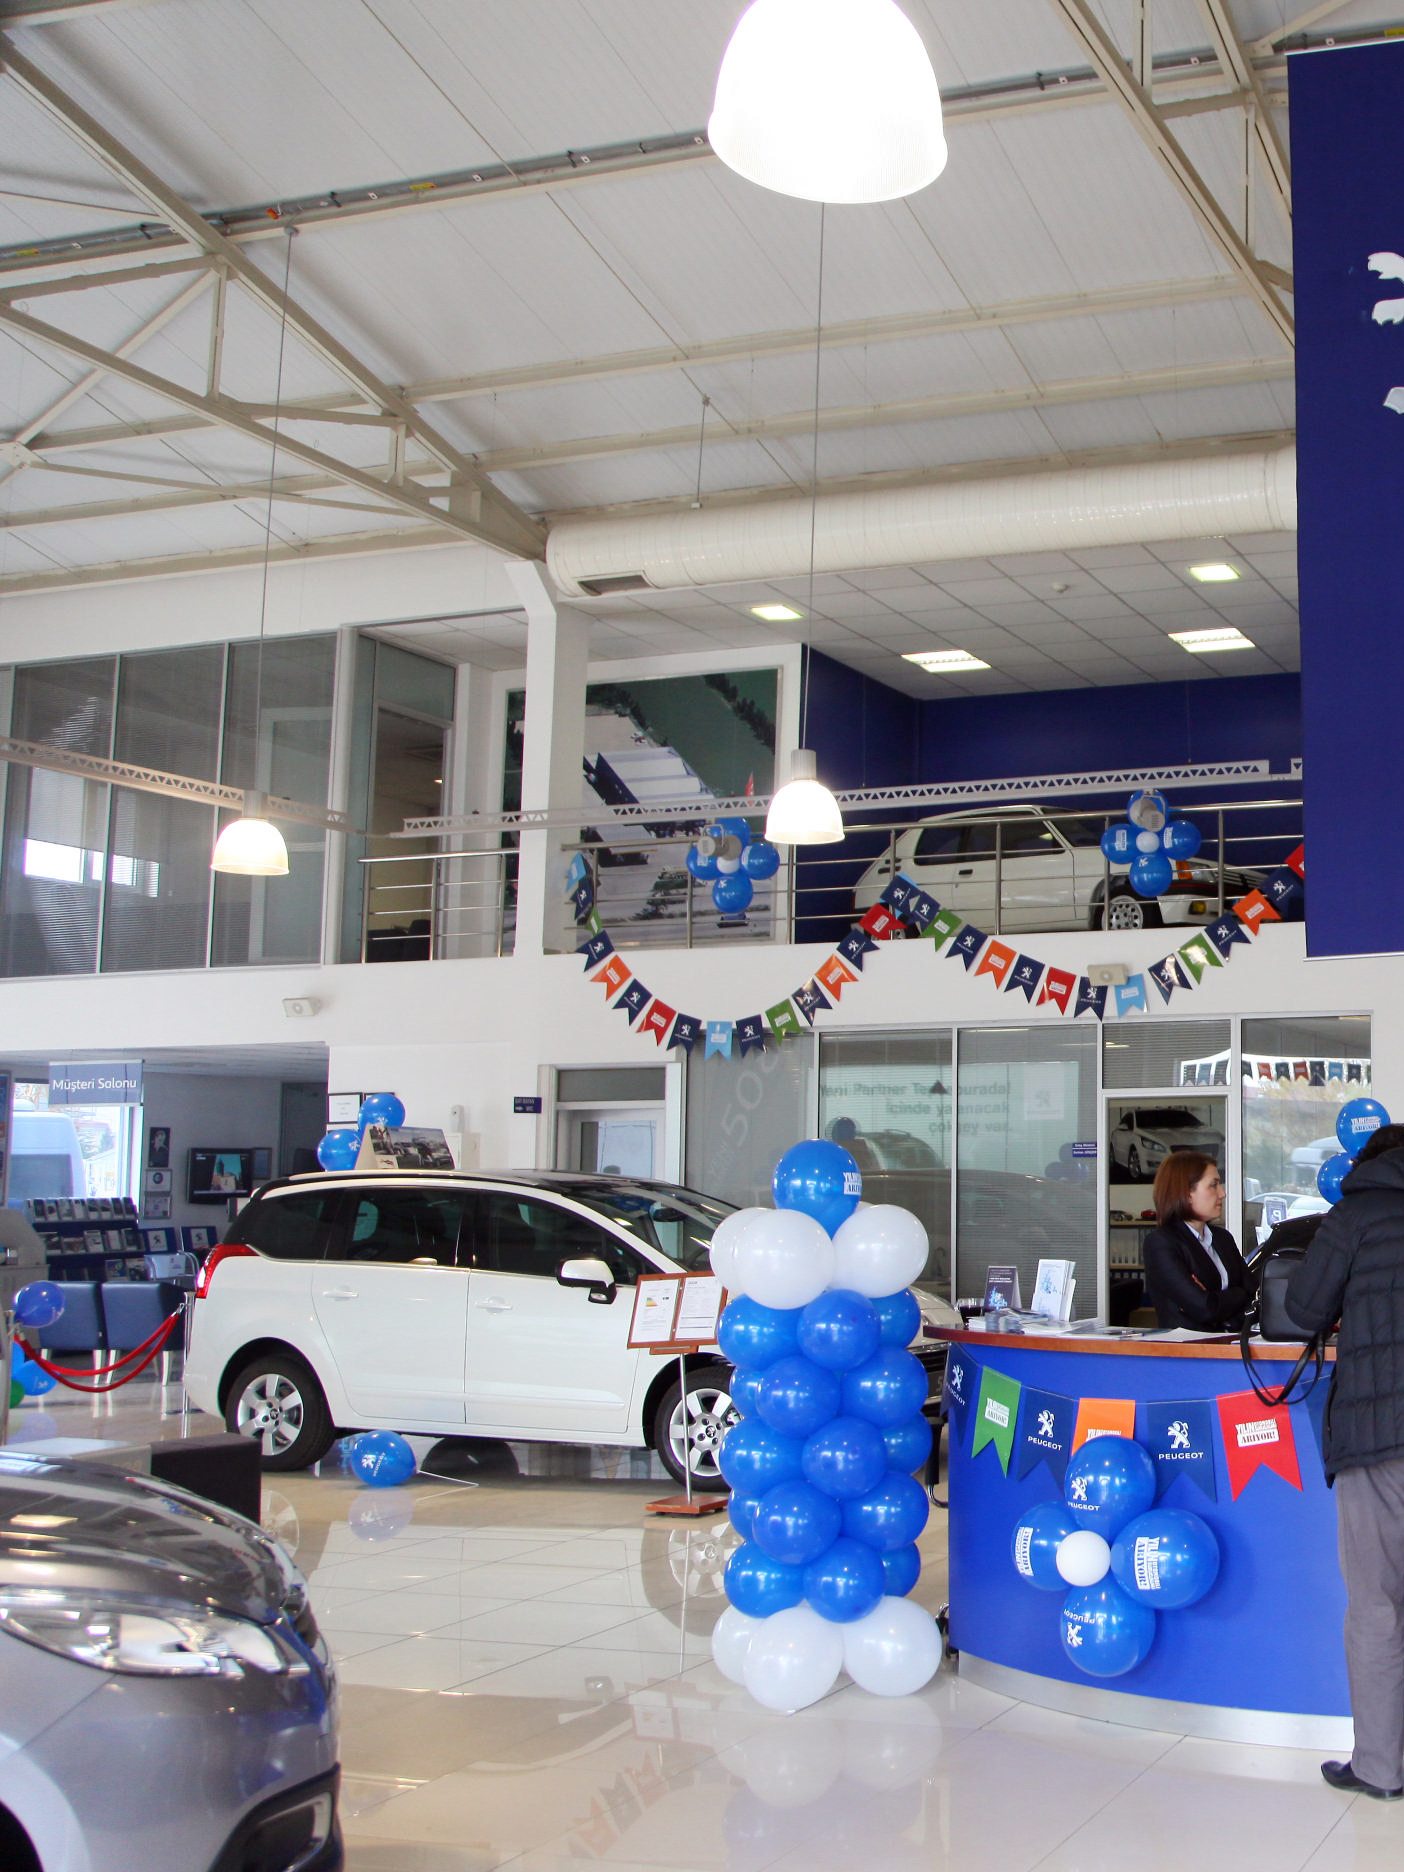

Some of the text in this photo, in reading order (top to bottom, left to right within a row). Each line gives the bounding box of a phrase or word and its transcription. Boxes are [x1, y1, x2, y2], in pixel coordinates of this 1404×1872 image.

[52, 1077, 137, 1092] Müşteri Salonu
[1027, 1435, 1063, 1451] PEUGEOT
[1241, 1430, 1276, 1445] ARIYOR!
[1158, 1451, 1204, 1460] PEUGEOT
[1067, 1501, 1100, 1512] PEUGEOT
[1137, 1542, 1148, 1586] ARIYOR!
